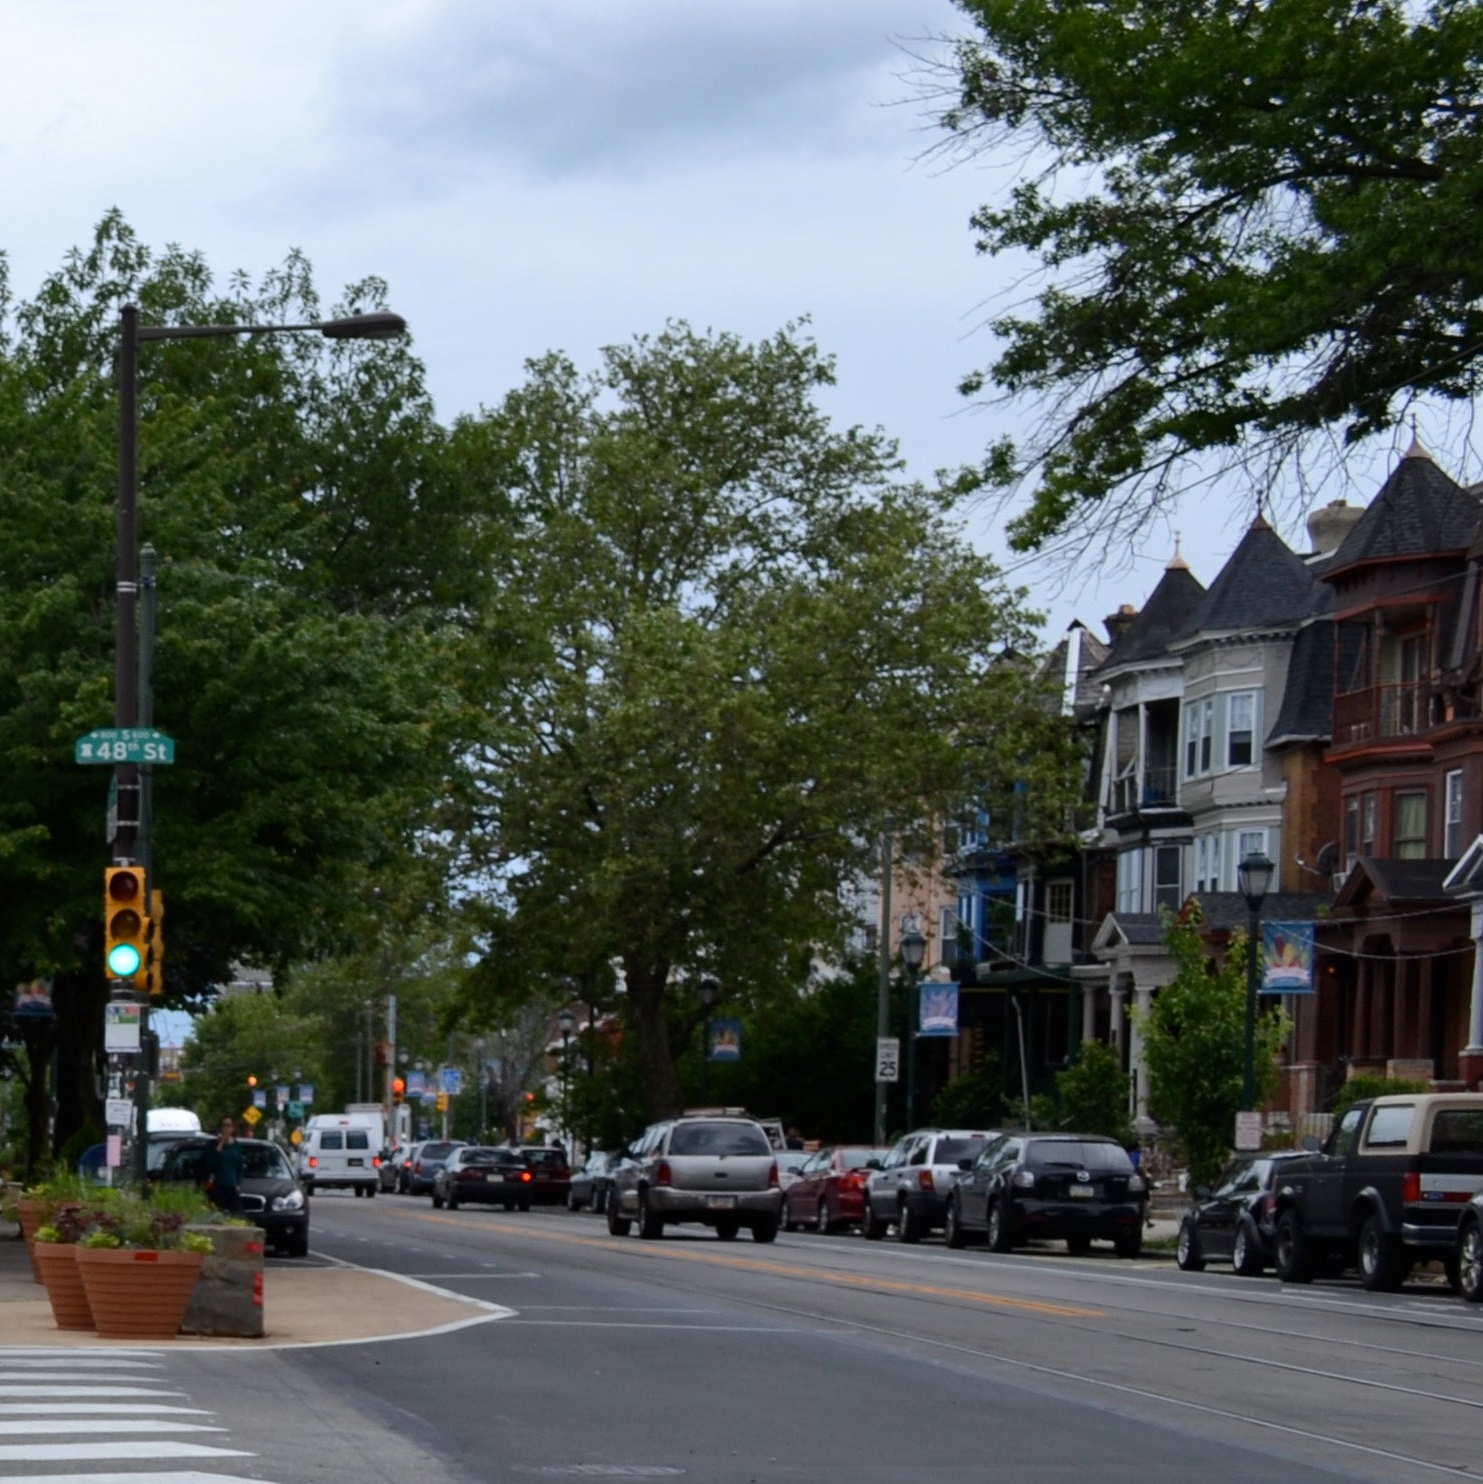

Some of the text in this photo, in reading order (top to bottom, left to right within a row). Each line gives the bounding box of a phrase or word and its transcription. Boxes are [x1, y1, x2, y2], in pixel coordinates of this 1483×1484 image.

[122, 729, 131, 740] S
[96, 741, 167, 760] 48th St
[879, 1061, 897, 1077] 25
